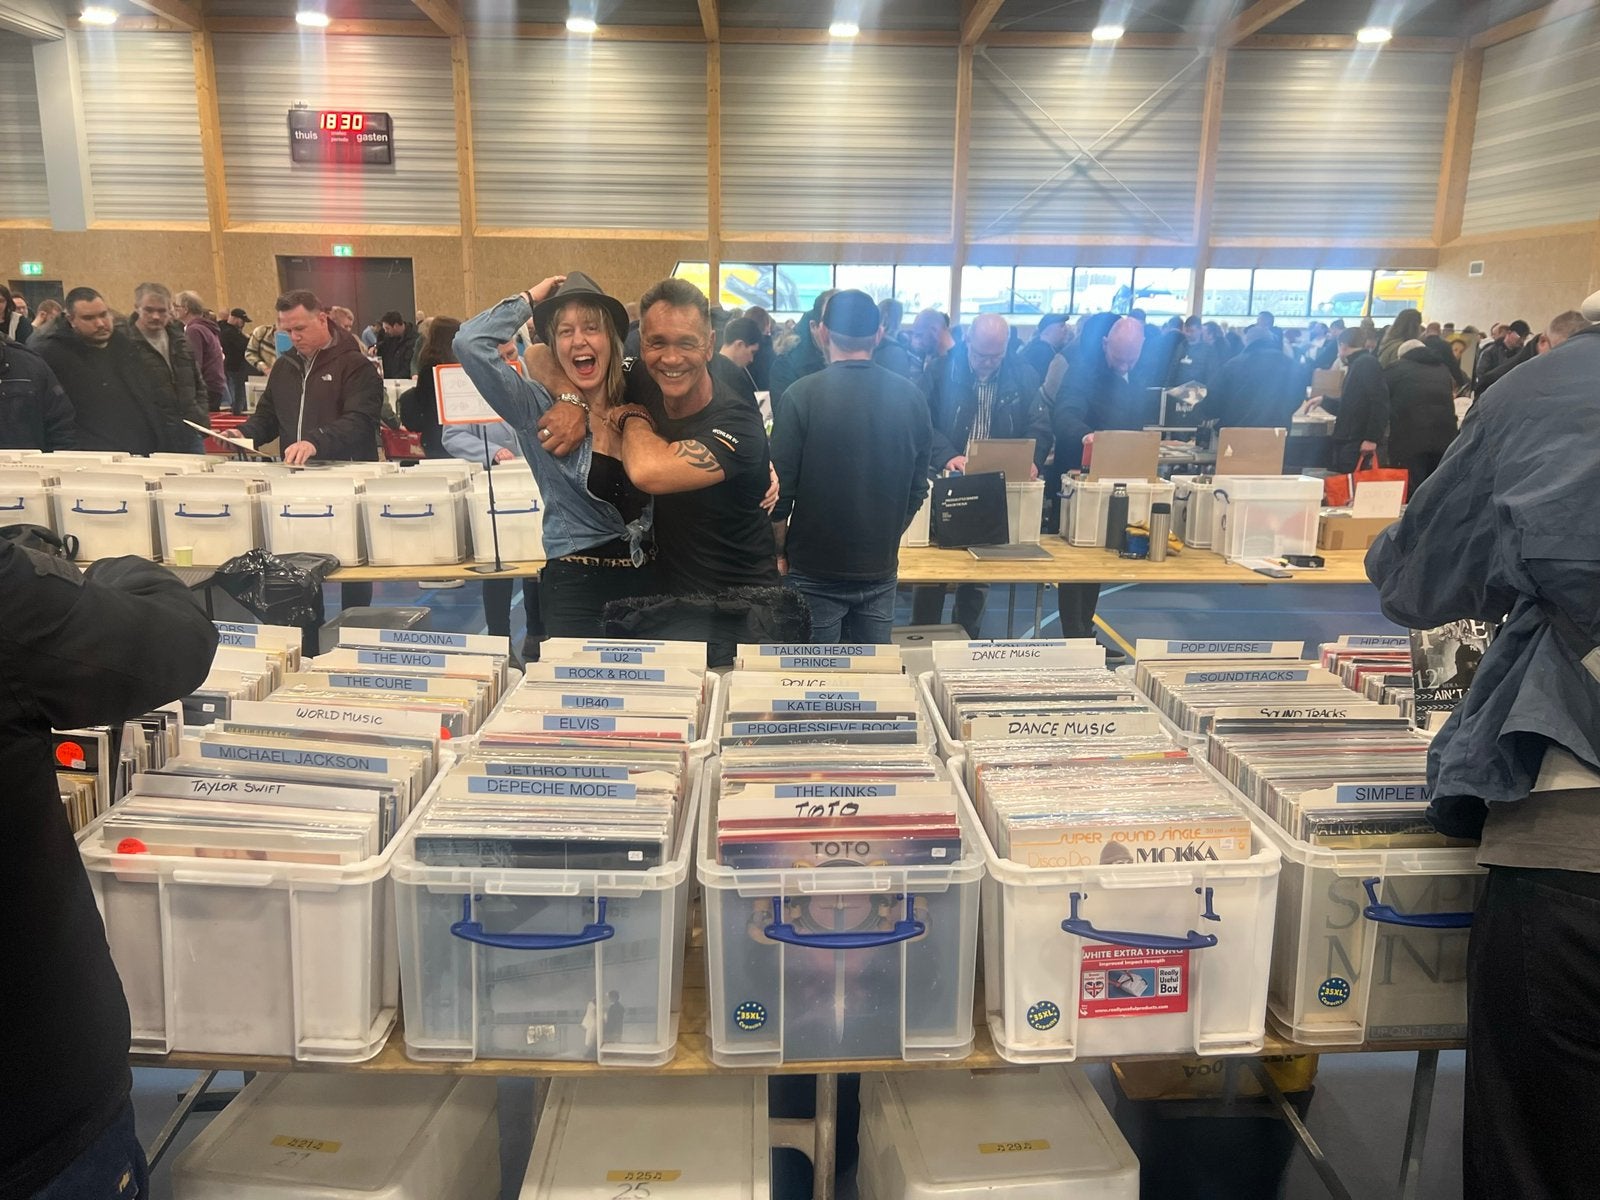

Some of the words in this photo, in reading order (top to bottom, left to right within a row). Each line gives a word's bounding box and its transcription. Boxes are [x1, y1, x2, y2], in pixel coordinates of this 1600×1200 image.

[294, 131, 318, 140] thuis
[356, 133, 388, 143] gasten
[393, 632, 453, 645] MADONNA
[1360, 638, 1379, 646] HIP
[773, 646, 821, 656] TALKING
[824, 646, 863, 656] HEADS
[1181, 643, 1205, 652] POP
[1208, 643, 1260, 653] DIVERSE
[372, 653, 397, 663] THE
[401, 655, 431, 666] WHO
[614, 653, 629, 662] U2
[972, 650, 1007, 661] DANCE
[1010, 648, 1041, 659] MUSIC
[793, 658, 837, 668] PRINCE
[569, 668, 604, 679] ROCK
[607, 670, 615, 679] &
[619, 670, 651, 680] ROLL
[1199, 671, 1294, 683] SOUNDTRACKS
[344, 676, 371, 687] THE
[375, 677, 413, 690] CURE
[1434, 689, 1463, 700] AIN'T
[576, 697, 609, 708] UB40
[787, 701, 821, 711] KATE
[825, 701, 861, 711] BUSH
[296, 707, 339, 720] WORLD
[342, 711, 384, 725] MUSIC
[560, 717, 600, 730] ELVIS
[748, 723, 857, 734] PROGRESSIEVE
[862, 723, 901, 731] ROCK
[1008, 721, 1060, 736] DANCE
[1064, 721, 1117, 736] MUSIC
[219, 746, 291, 764] MICHAEL
[294, 752, 370, 770] JACKSON
[504, 765, 567, 777] JETHRO
[571, 766, 611, 778] TULL
[191, 780, 239, 796] TAYLOR
[244, 782, 285, 795] SWIFT
[487, 779, 565, 795] DEPECHE
[569, 783, 617, 797] MODE
[793, 785, 825, 797] THE
[829, 785, 878, 797] KINKS
[1355, 787, 1415, 801] SIMPLE
[795, 800, 860, 817] TOTO
[1058, 831, 1102, 844] SUPER
[1110, 829, 1156, 843] SOUND
[810, 841, 870, 858] TOTO
[1136, 841, 1219, 863] MOKKA
[1083, 950, 1112, 960] WHITE
[1114, 949, 1144, 958] EXTRA
[1160, 969, 1179, 977] Really
[1160, 984, 1178, 993] Box
[1325, 988, 1343, 996] 35XL
[741, 1012, 761, 1020] 35XL
[1033, 1009, 1053, 1021] 35XL
